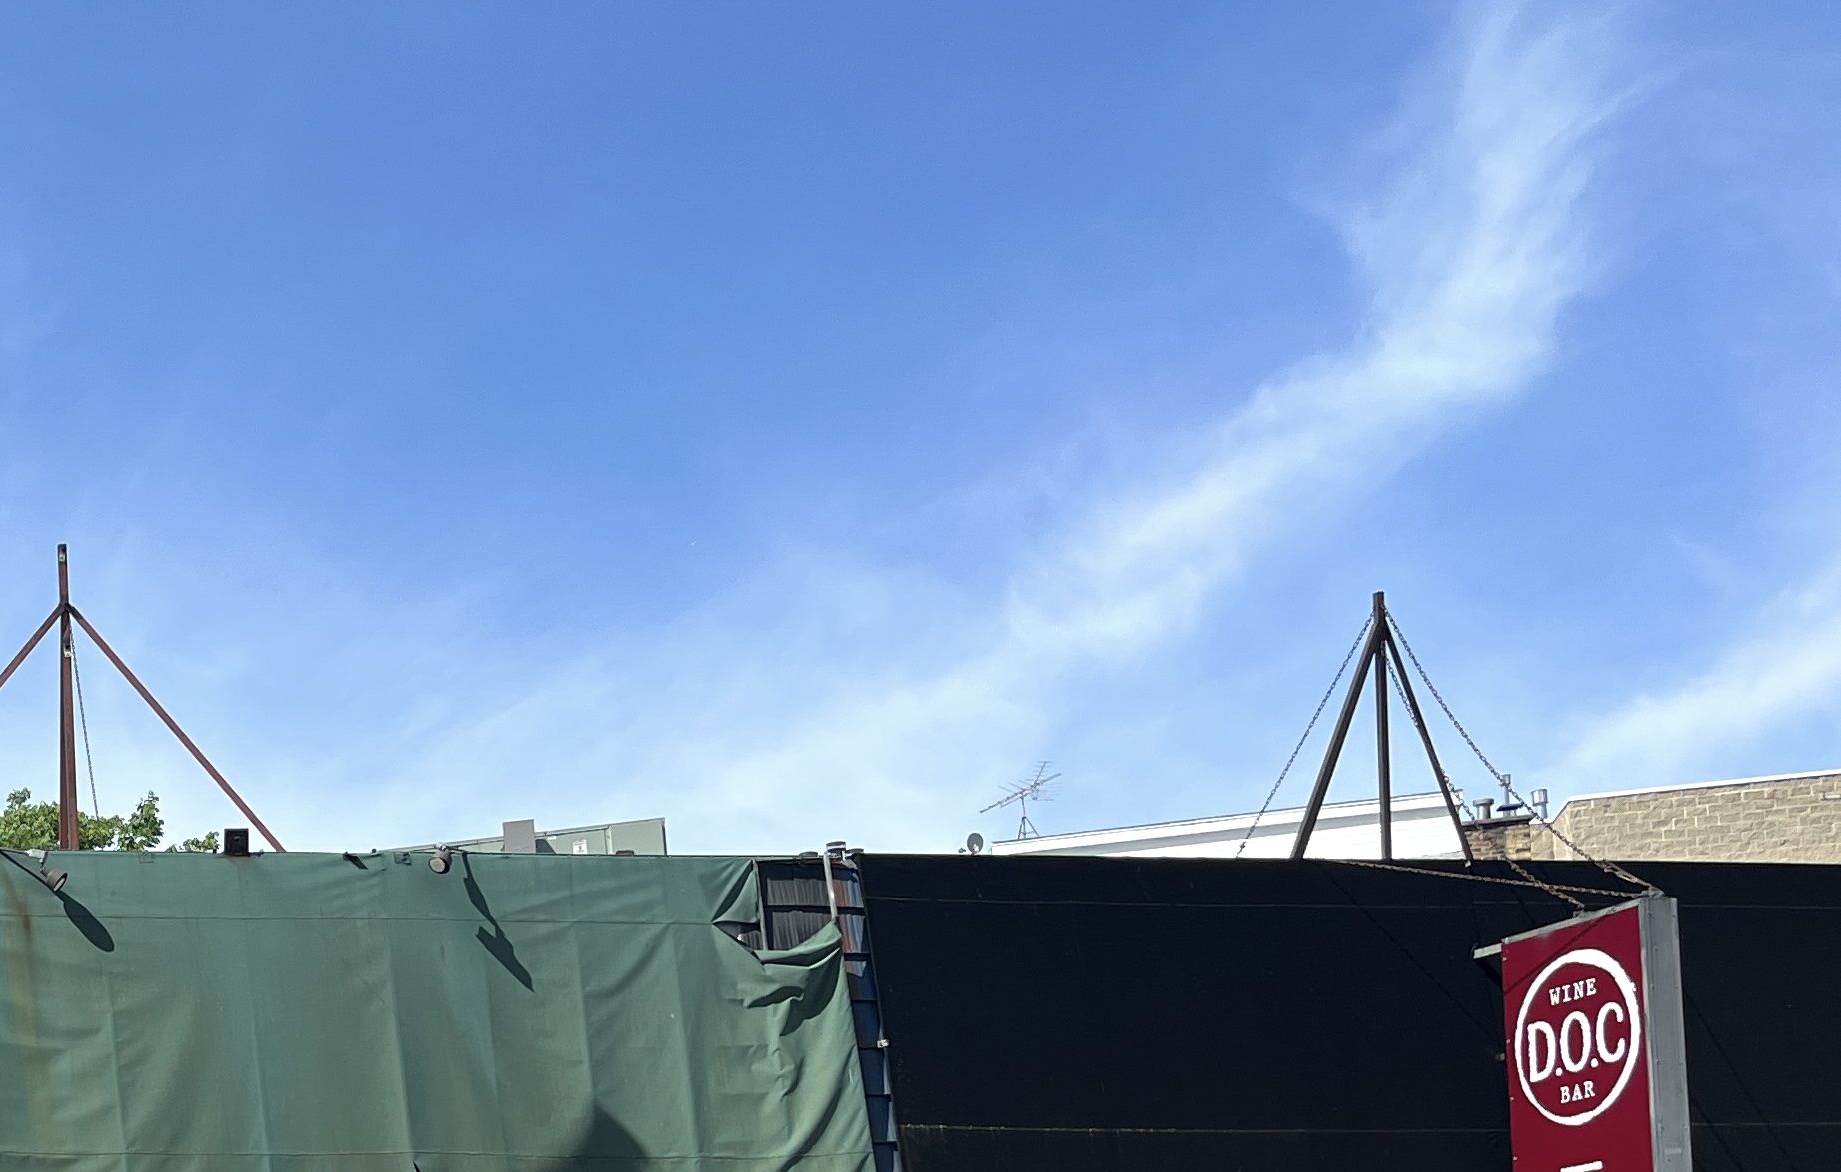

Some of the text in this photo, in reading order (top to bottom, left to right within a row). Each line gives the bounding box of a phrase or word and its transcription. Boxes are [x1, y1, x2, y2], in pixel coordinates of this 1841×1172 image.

[1549, 978, 1597, 1005] WINE
[1527, 1002, 1626, 1083] D.O.C
[1560, 1081, 1596, 1103] BAR
